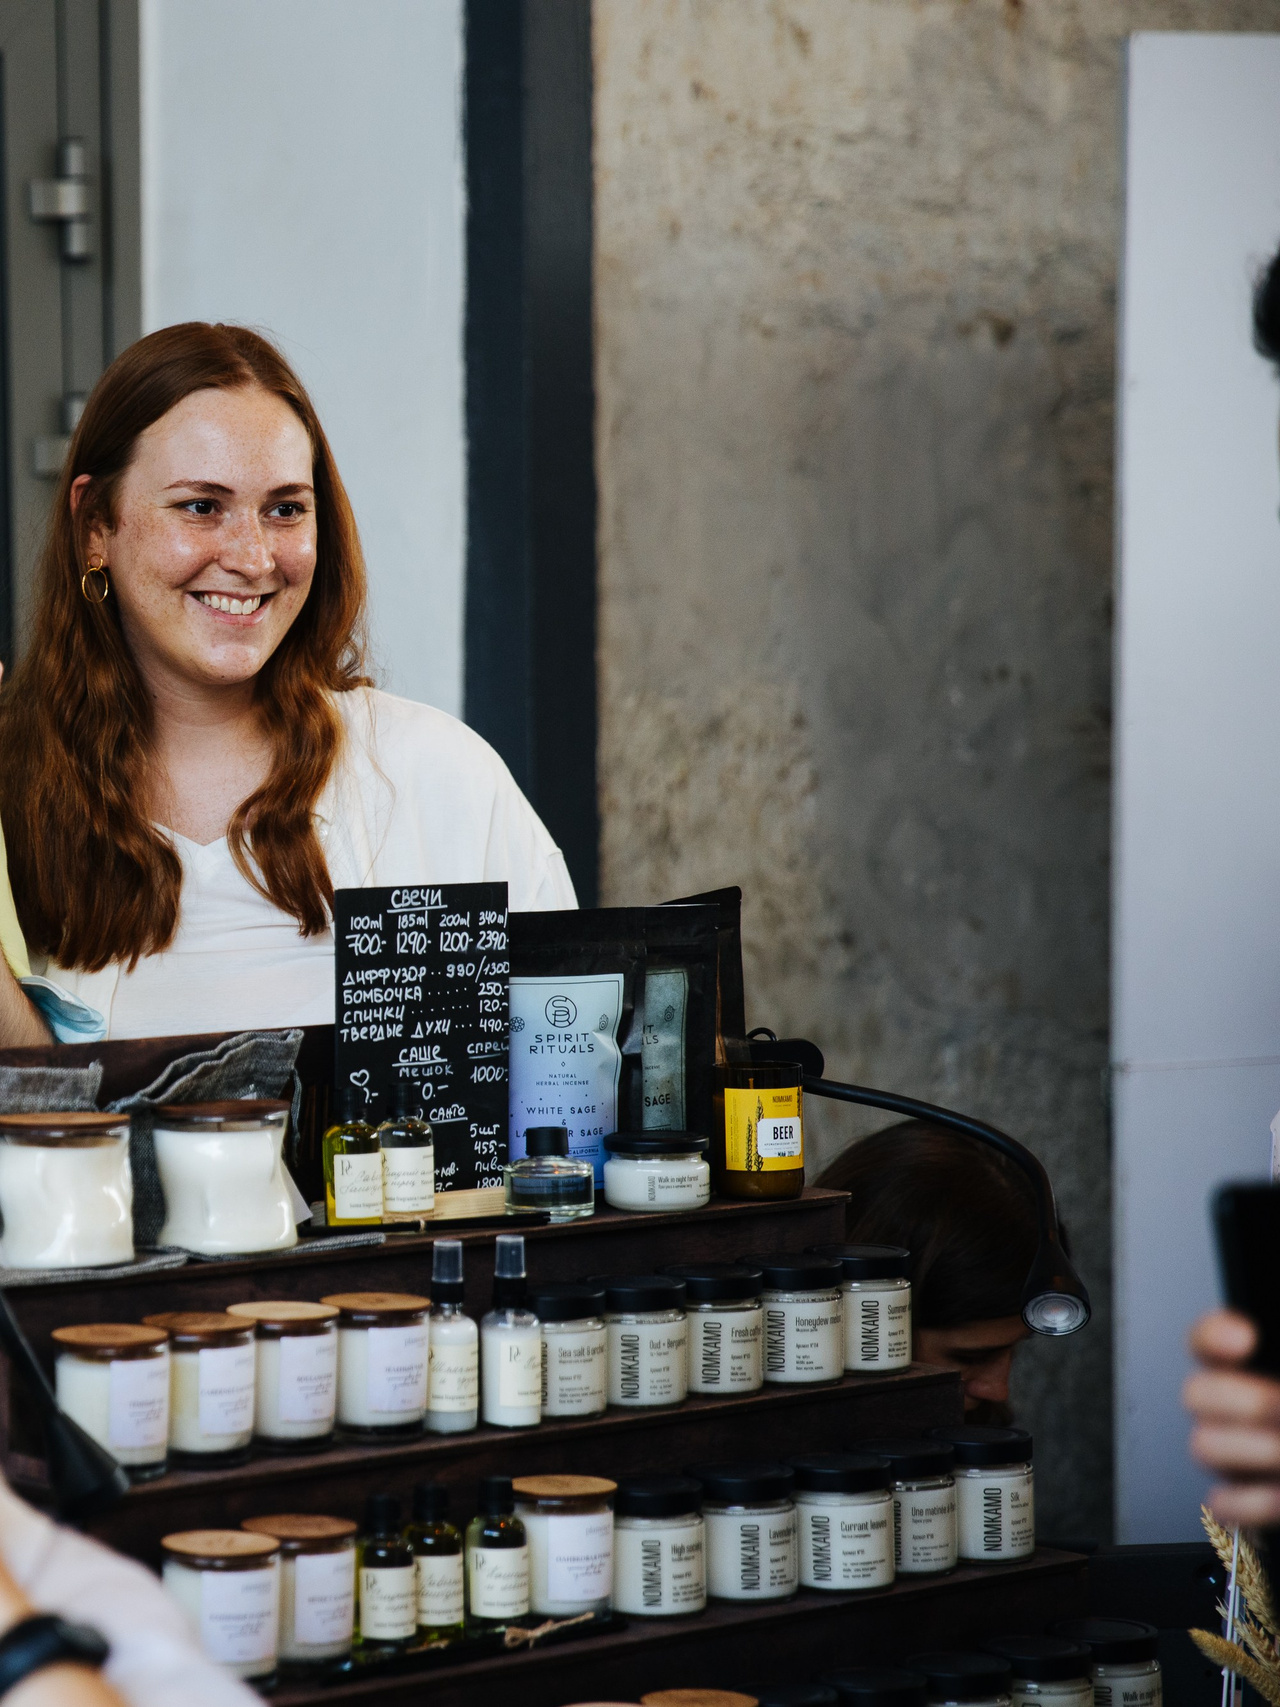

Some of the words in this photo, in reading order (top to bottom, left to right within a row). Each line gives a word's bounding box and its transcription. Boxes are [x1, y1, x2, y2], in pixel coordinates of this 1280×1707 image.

[350, 914, 383, 931] 100ml
[398, 912, 429, 929] 185ml
[439, 911, 470, 928] 200ml
[478, 907, 508, 928] 340ml
[343, 986, 422, 1004] БОМБОЧКА
[535, 1033, 590, 1044] SPIRIT
[529, 1043, 595, 1055] RITUALS
[644, 1094, 671, 1107] SAGE
[526, 1106, 564, 1115] WHITE
[570, 1105, 597, 1114] SAGE
[580, 1127, 604, 1137] SAGE
[773, 1125, 794, 1140] BEER
[795, 1315, 829, 1330] Honeydew
[731, 1326, 749, 1338] Fresh
[861, 1300, 880, 1362] NOMKAMO
[767, 1310, 786, 1373] NOMKAMO
[558, 1347, 571, 1357] Sea
[573, 1346, 585, 1357] salt
[702, 1321, 722, 1385] NOMKAMO
[620, 1334, 640, 1399] NOMKAMO
[1010, 1491, 1020, 1502] Silk
[911, 1507, 924, 1516] Une
[983, 1487, 1002, 1551] NOMKAMO
[840, 1520, 869, 1532] Currant
[811, 1515, 832, 1581] NOMKAMO
[740, 1524, 760, 1590] NOMKAMO
[641, 1539, 662, 1607] NOMKAMO
[1122, 1691, 1138, 1702] Walk
